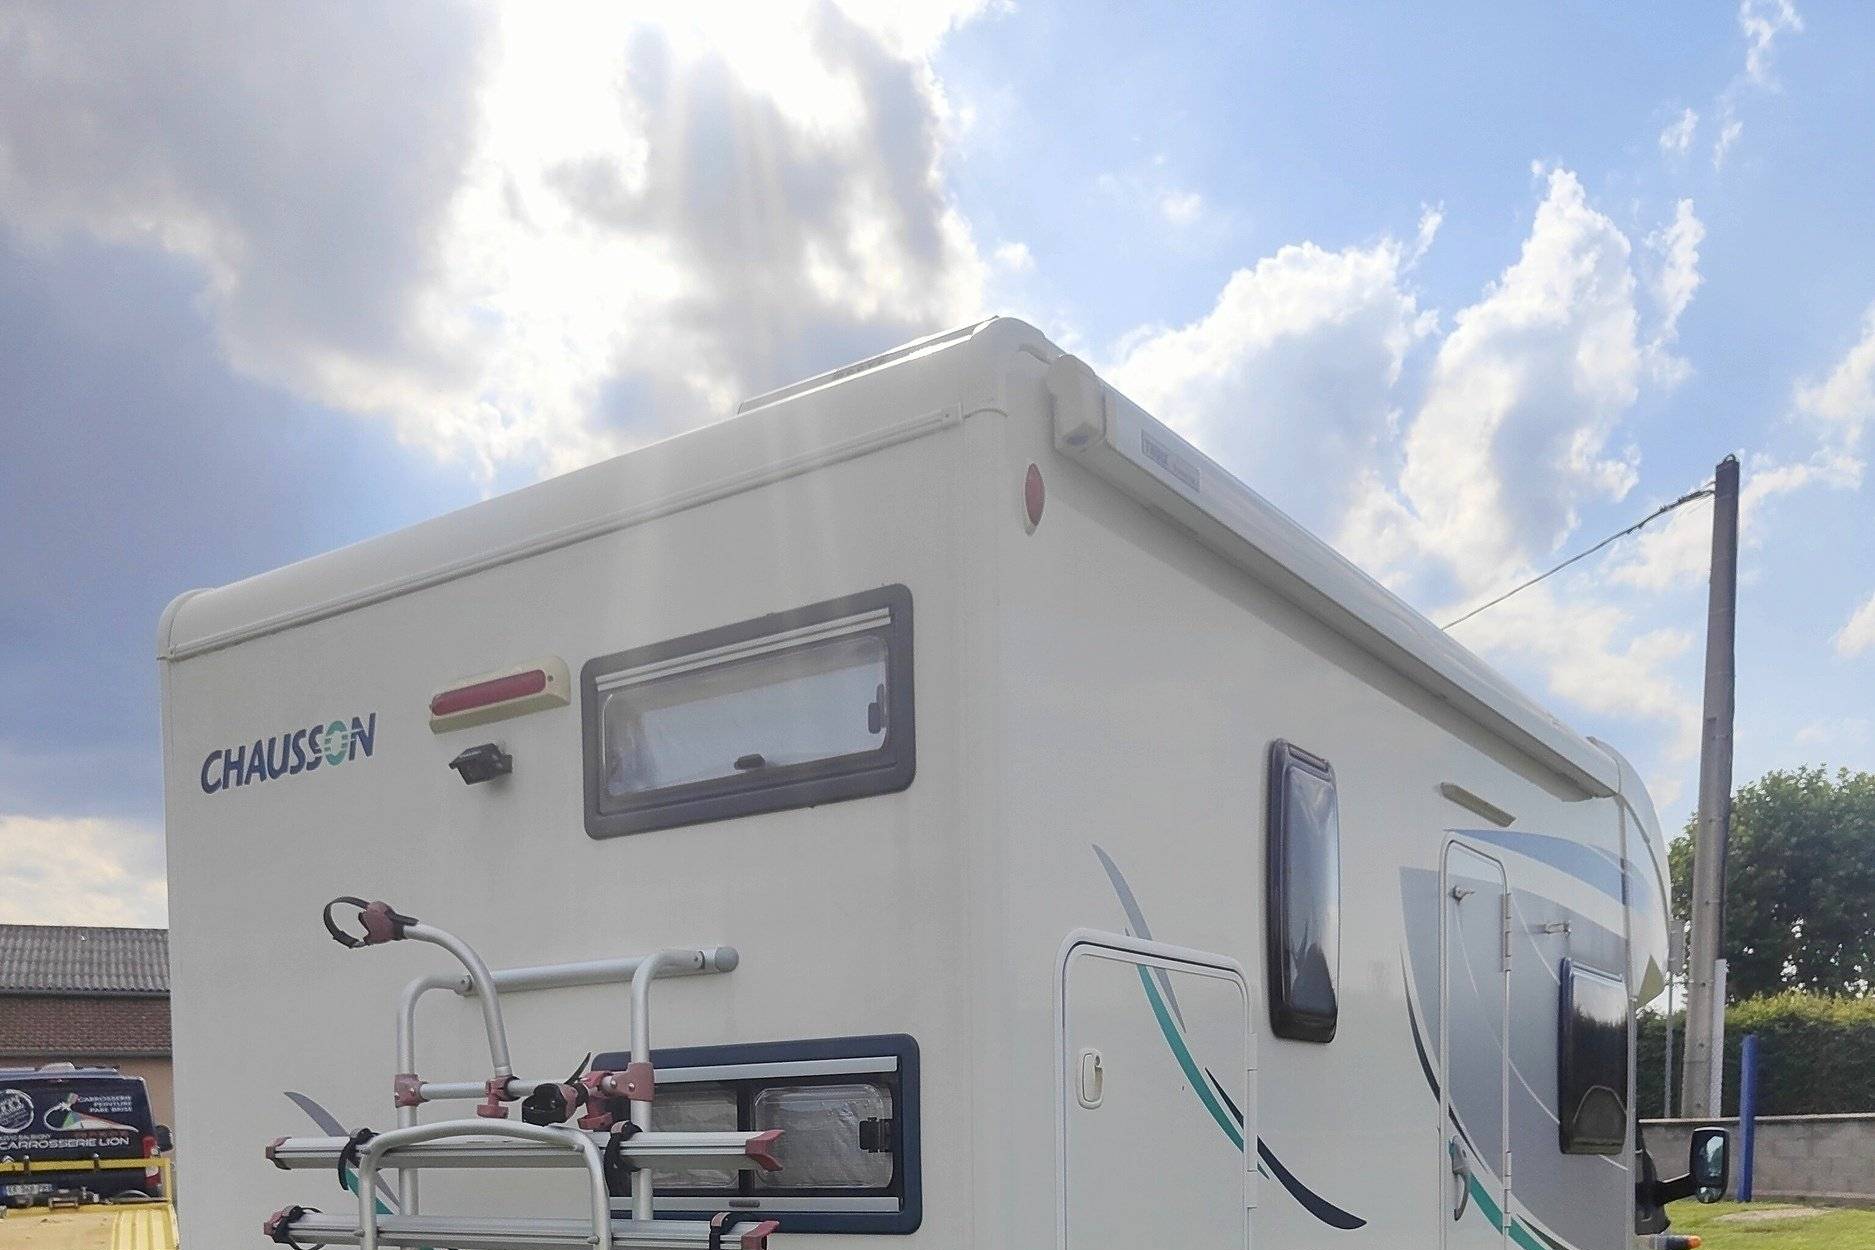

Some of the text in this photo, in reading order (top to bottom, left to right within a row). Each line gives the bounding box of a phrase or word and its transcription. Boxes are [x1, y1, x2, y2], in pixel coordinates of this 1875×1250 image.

[200, 712, 376, 795] CHAUSSON
[0, 1137, 130, 1150] CARROSSERIE LION
